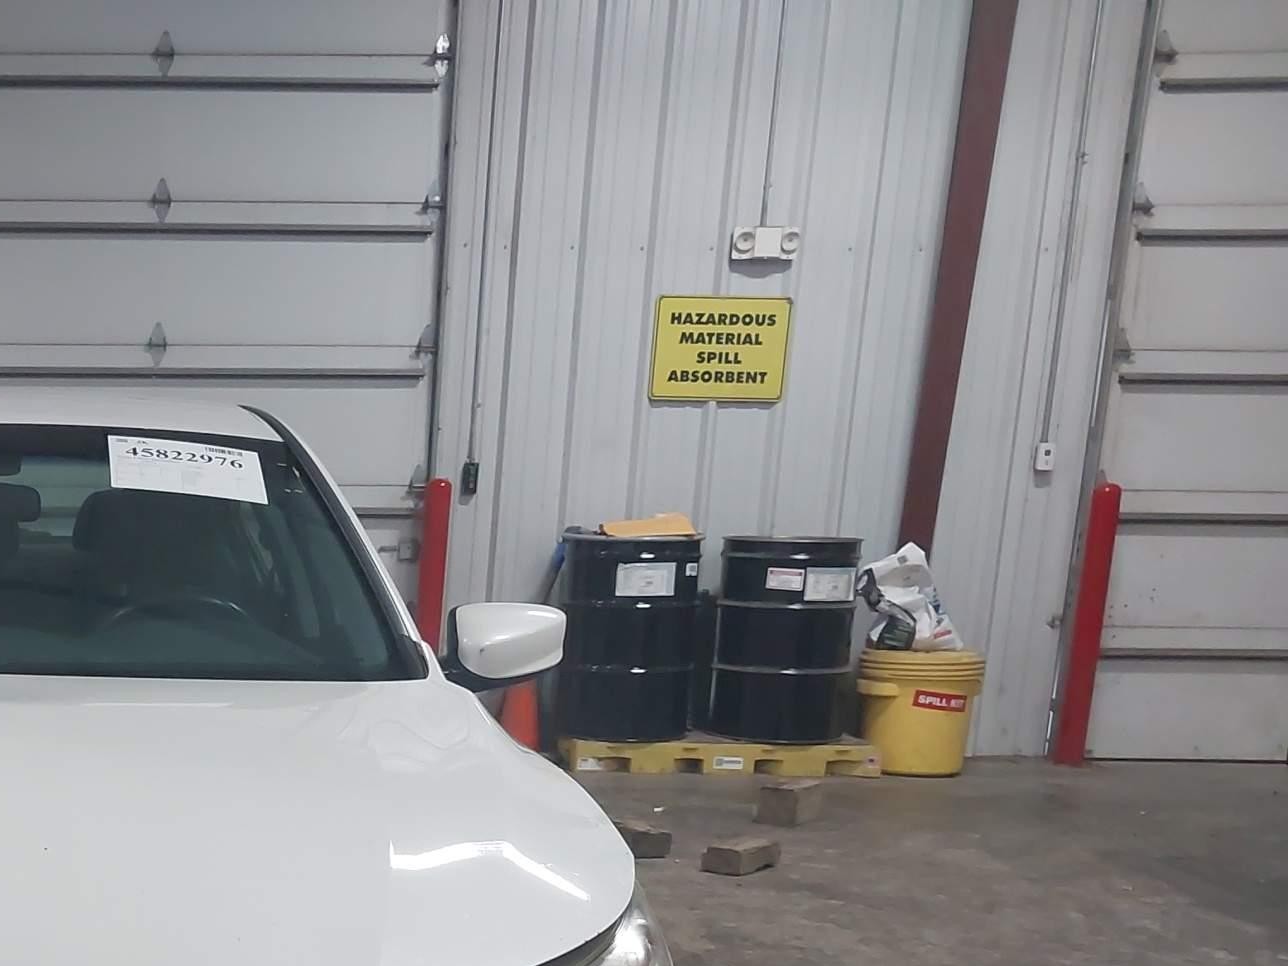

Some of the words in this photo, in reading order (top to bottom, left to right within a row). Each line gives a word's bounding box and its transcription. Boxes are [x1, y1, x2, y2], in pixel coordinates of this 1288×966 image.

[670, 312, 777, 327] HAZARDOUS
[679, 332, 763, 345] MATERIAL
[696, 351, 742, 364] SPILL
[667, 370, 768, 384] ABSORBENT
[125, 446, 244, 470] 45822976
[918, 695, 948, 707] SPILL
